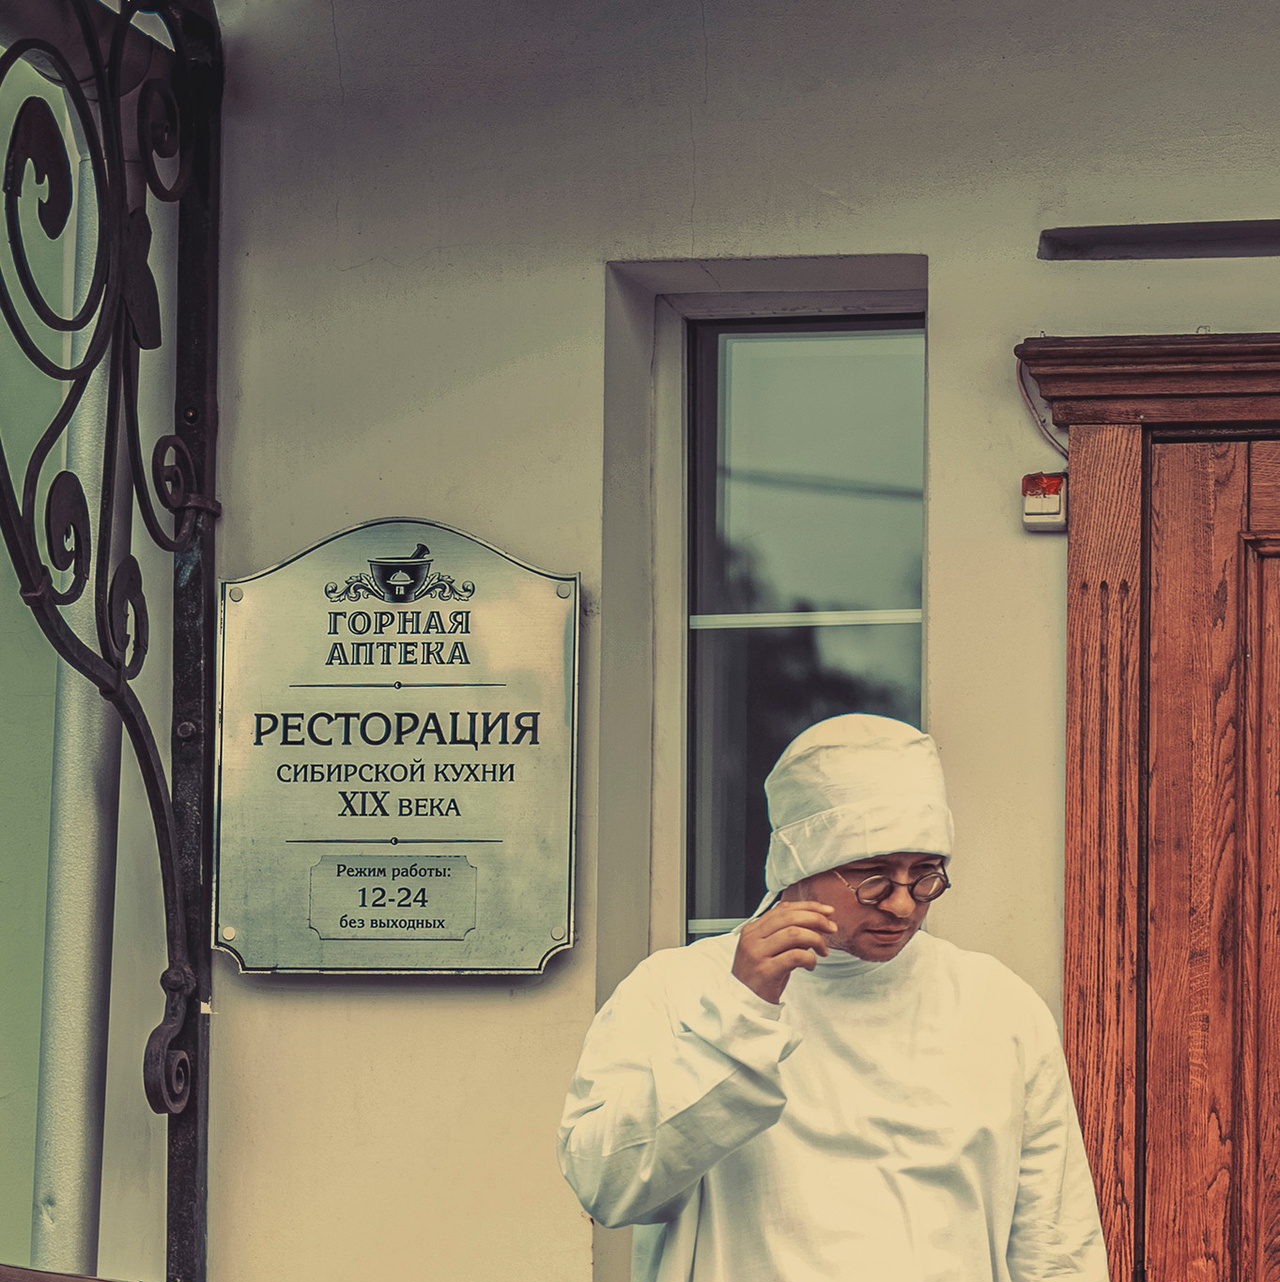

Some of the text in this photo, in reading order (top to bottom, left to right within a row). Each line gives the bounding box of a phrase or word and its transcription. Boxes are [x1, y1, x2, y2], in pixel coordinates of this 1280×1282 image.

[327, 610, 471, 636] ГОРНАЯ
[325, 641, 471, 666] АПТЕКА
[253, 711, 540, 751] РЕСТОРАЦИЯ
[276, 758, 516, 783] СИБИРСКОЙ КУХНИ
[337, 790, 462, 817] XIX ВЕКА
[336, 863, 451, 881] Режим работы:
[357, 887, 429, 908] 12-24
[339, 914, 446, 931] без выходных
